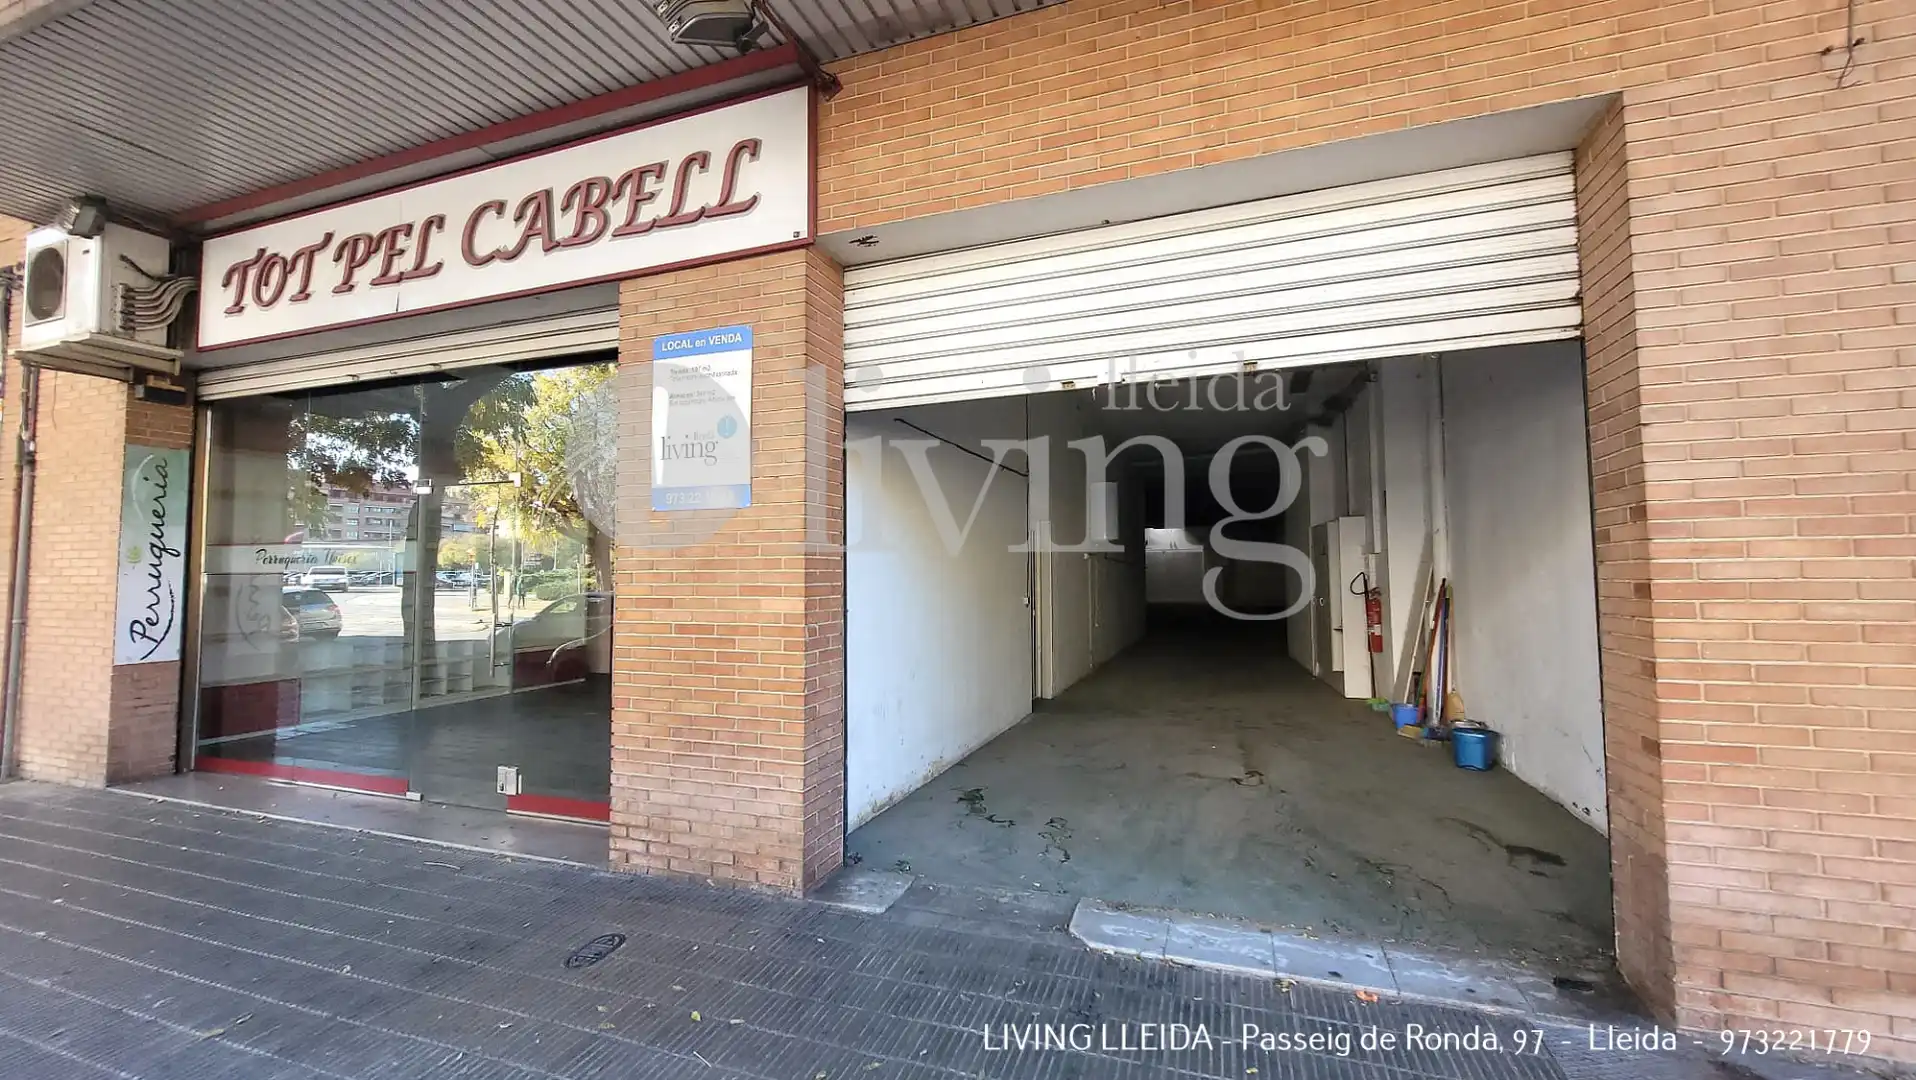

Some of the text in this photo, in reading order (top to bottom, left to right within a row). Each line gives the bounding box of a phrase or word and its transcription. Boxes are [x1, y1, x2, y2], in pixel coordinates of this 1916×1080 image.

[221, 137, 763, 317] TOT PEL CABELL
[661, 332, 743, 352] LOCAL en VENDA
[660, 435, 719, 467] living
[129, 457, 181, 650] Perruqueria
